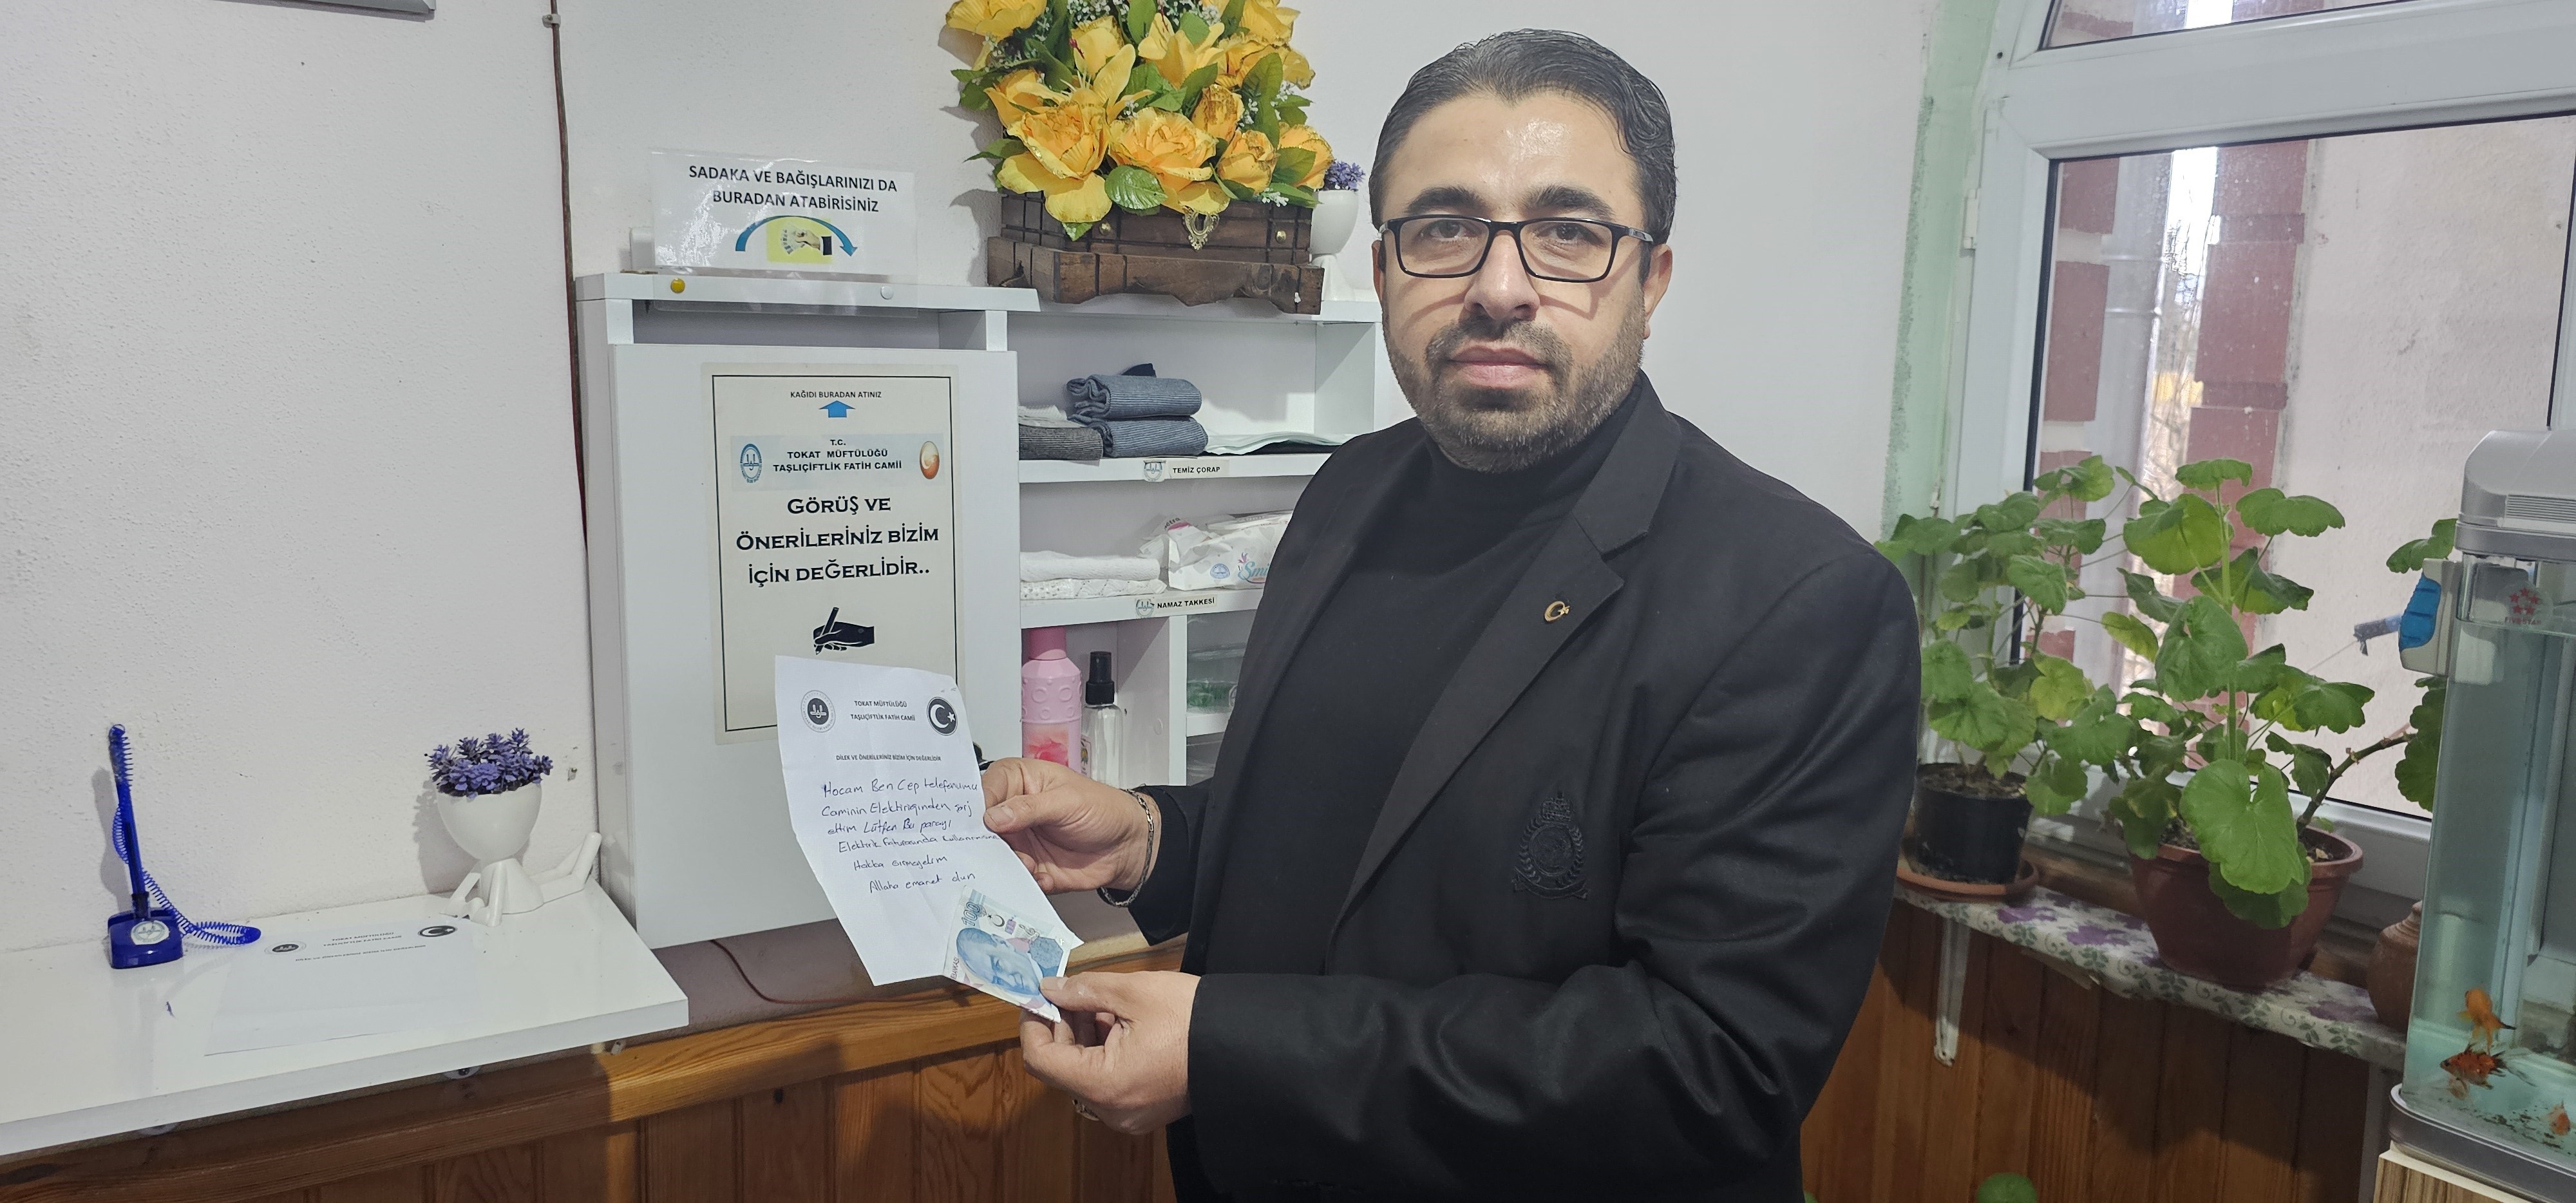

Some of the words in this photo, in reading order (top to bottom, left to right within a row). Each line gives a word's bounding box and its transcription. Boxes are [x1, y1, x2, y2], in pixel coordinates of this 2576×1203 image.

[689, 166, 749, 182] SADAKA
[754, 170, 772, 183] VE
[776, 170, 875, 191] BAĞIŞLARINIZI
[878, 180, 897, 192] DA
[712, 191, 786, 207] BURADAN
[790, 194, 879, 212] ATABİRİSİNİZ
[790, 390, 817, 398] KAĞIDI
[827, 448, 888, 458] MÜFTÜLÜĞÜ
[773, 462, 841, 473] TAŞLIÇİFTLİK
[844, 461, 871, 470] FATİH
[875, 460, 902, 469] CAMİİ
[787, 495, 858, 515] GÖRÜŞ
[864, 497, 891, 511] VE
[736, 524, 883, 551] ÖNERİLERİNİZ
[887, 522, 939, 543] BİZİM
[748, 562, 790, 587] İÇİN
[796, 556, 930, 582] DEĞERLİDİR..
[1157, 601, 1182, 609] NAMAZ
[1184, 596, 1215, 607] TAKKESİ
[823, 781, 863, 798] Hocam
[871, 778, 893, 792] Ben
[897, 779, 919, 794] Cep
[822, 806, 867, 816] Caminin
[828, 823, 857, 835] ettim
[903, 817, 914, 830] Bu
[905, 874, 942, 889] emanet
[961, 902, 981, 926] 100
